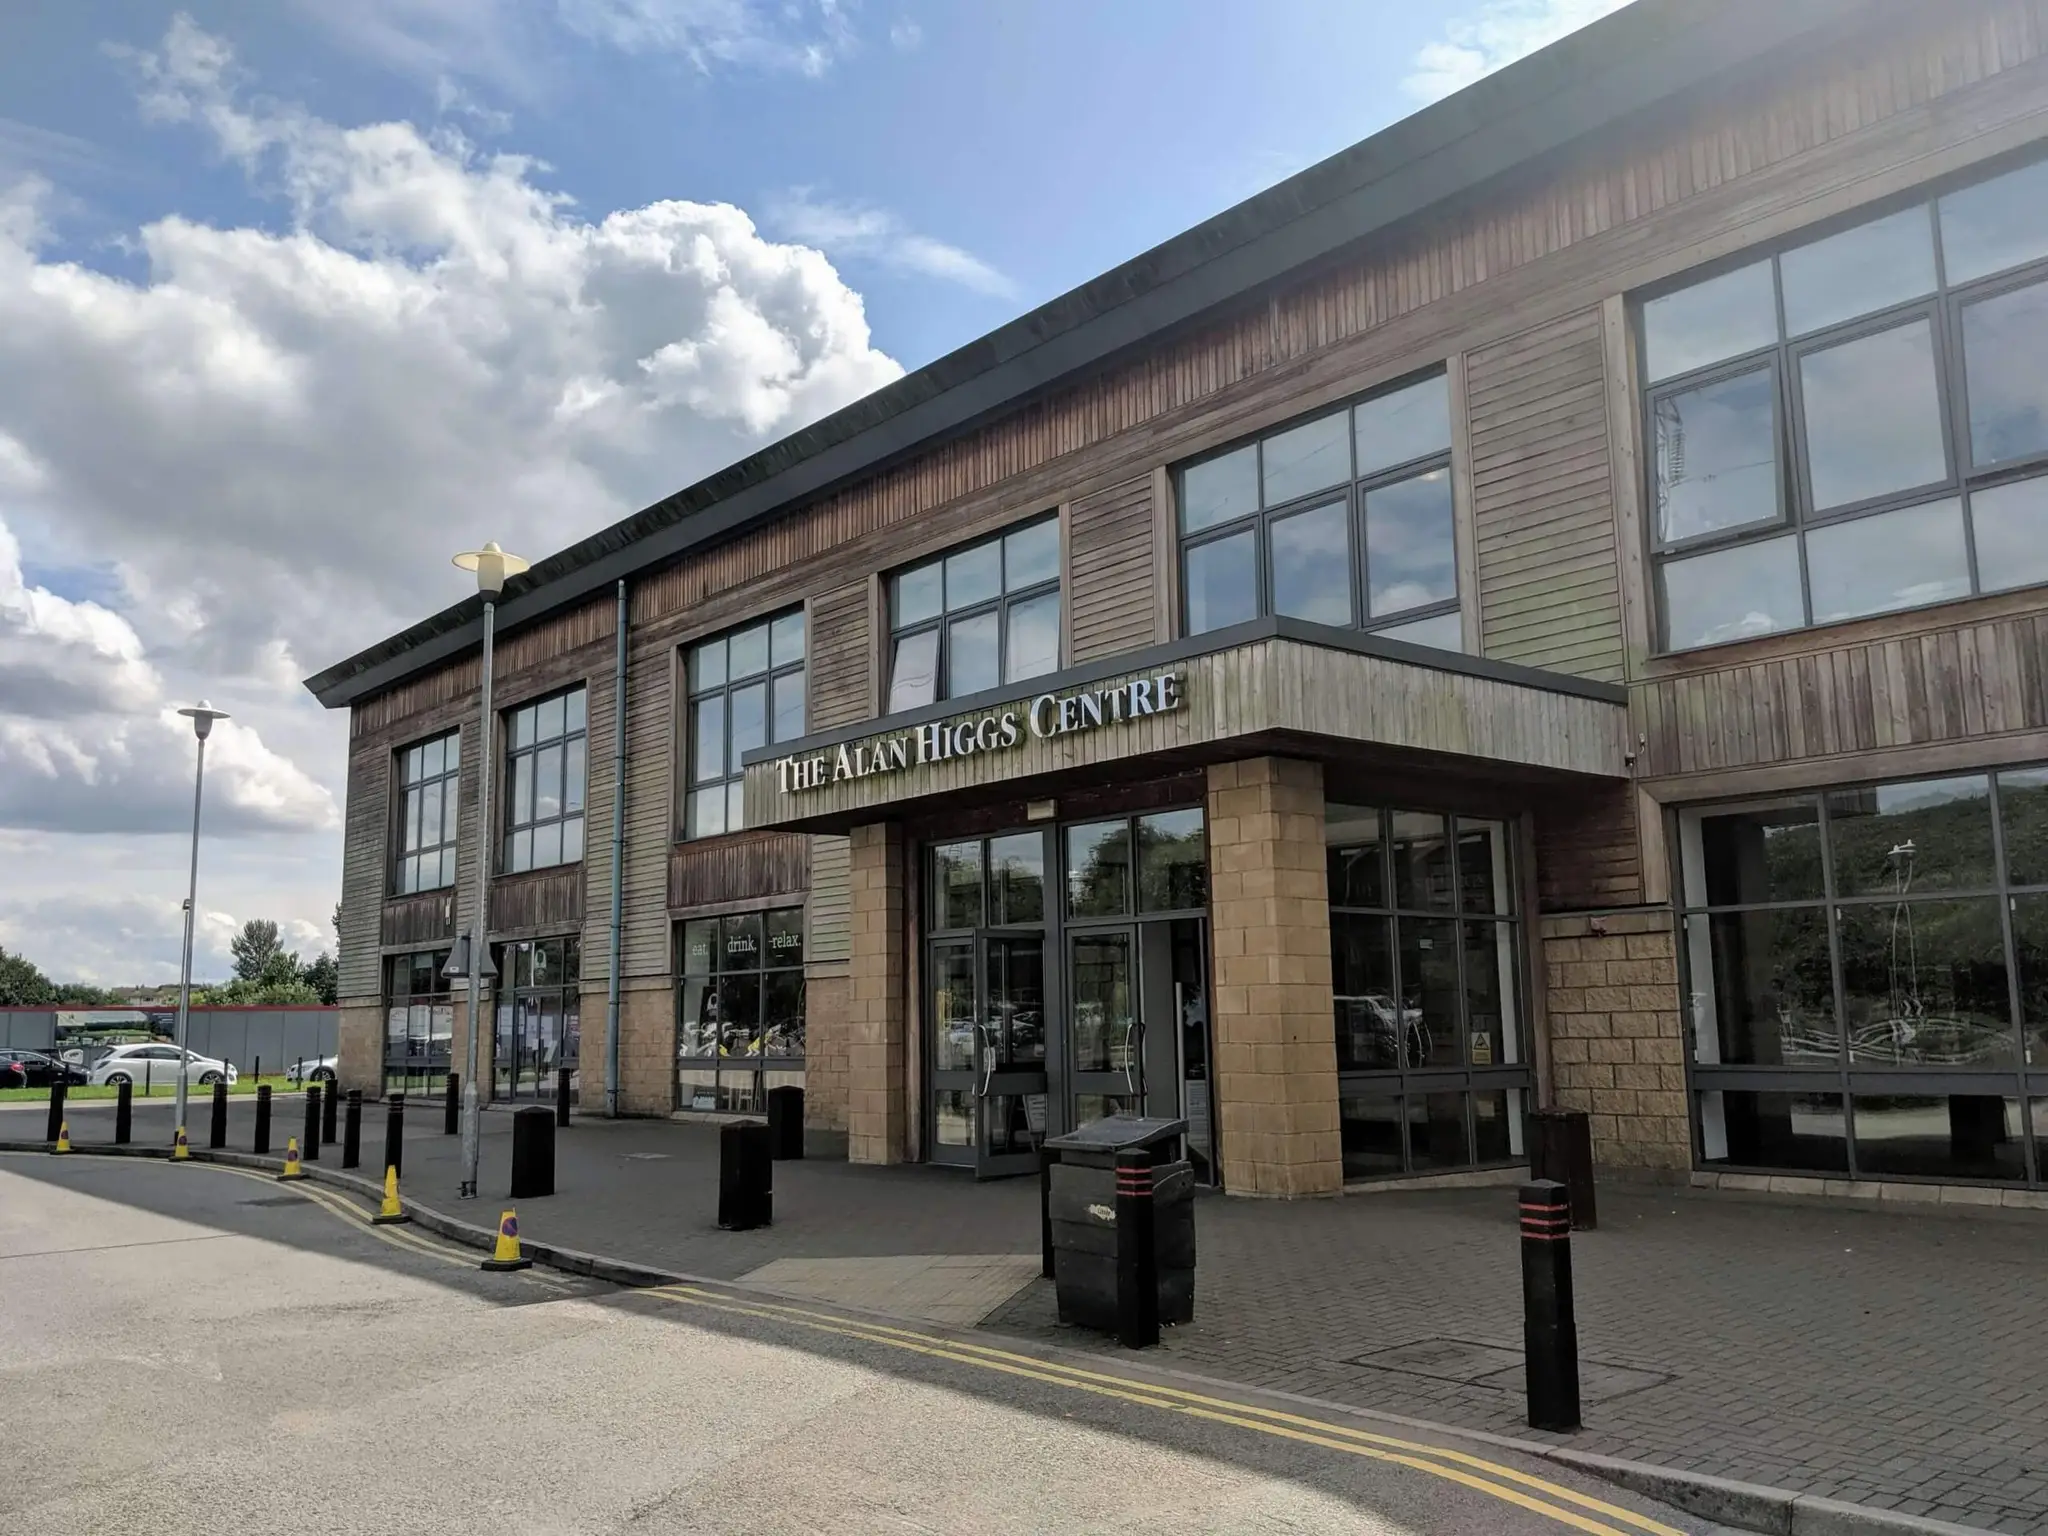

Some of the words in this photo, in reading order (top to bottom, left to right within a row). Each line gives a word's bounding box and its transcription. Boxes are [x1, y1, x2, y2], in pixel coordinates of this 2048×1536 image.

[775, 754, 827, 794] THE
[832, 736, 907, 782] ALAN
[915, 711, 1017, 764] HIGGS
[1030, 672, 1179, 739] CENTRE
